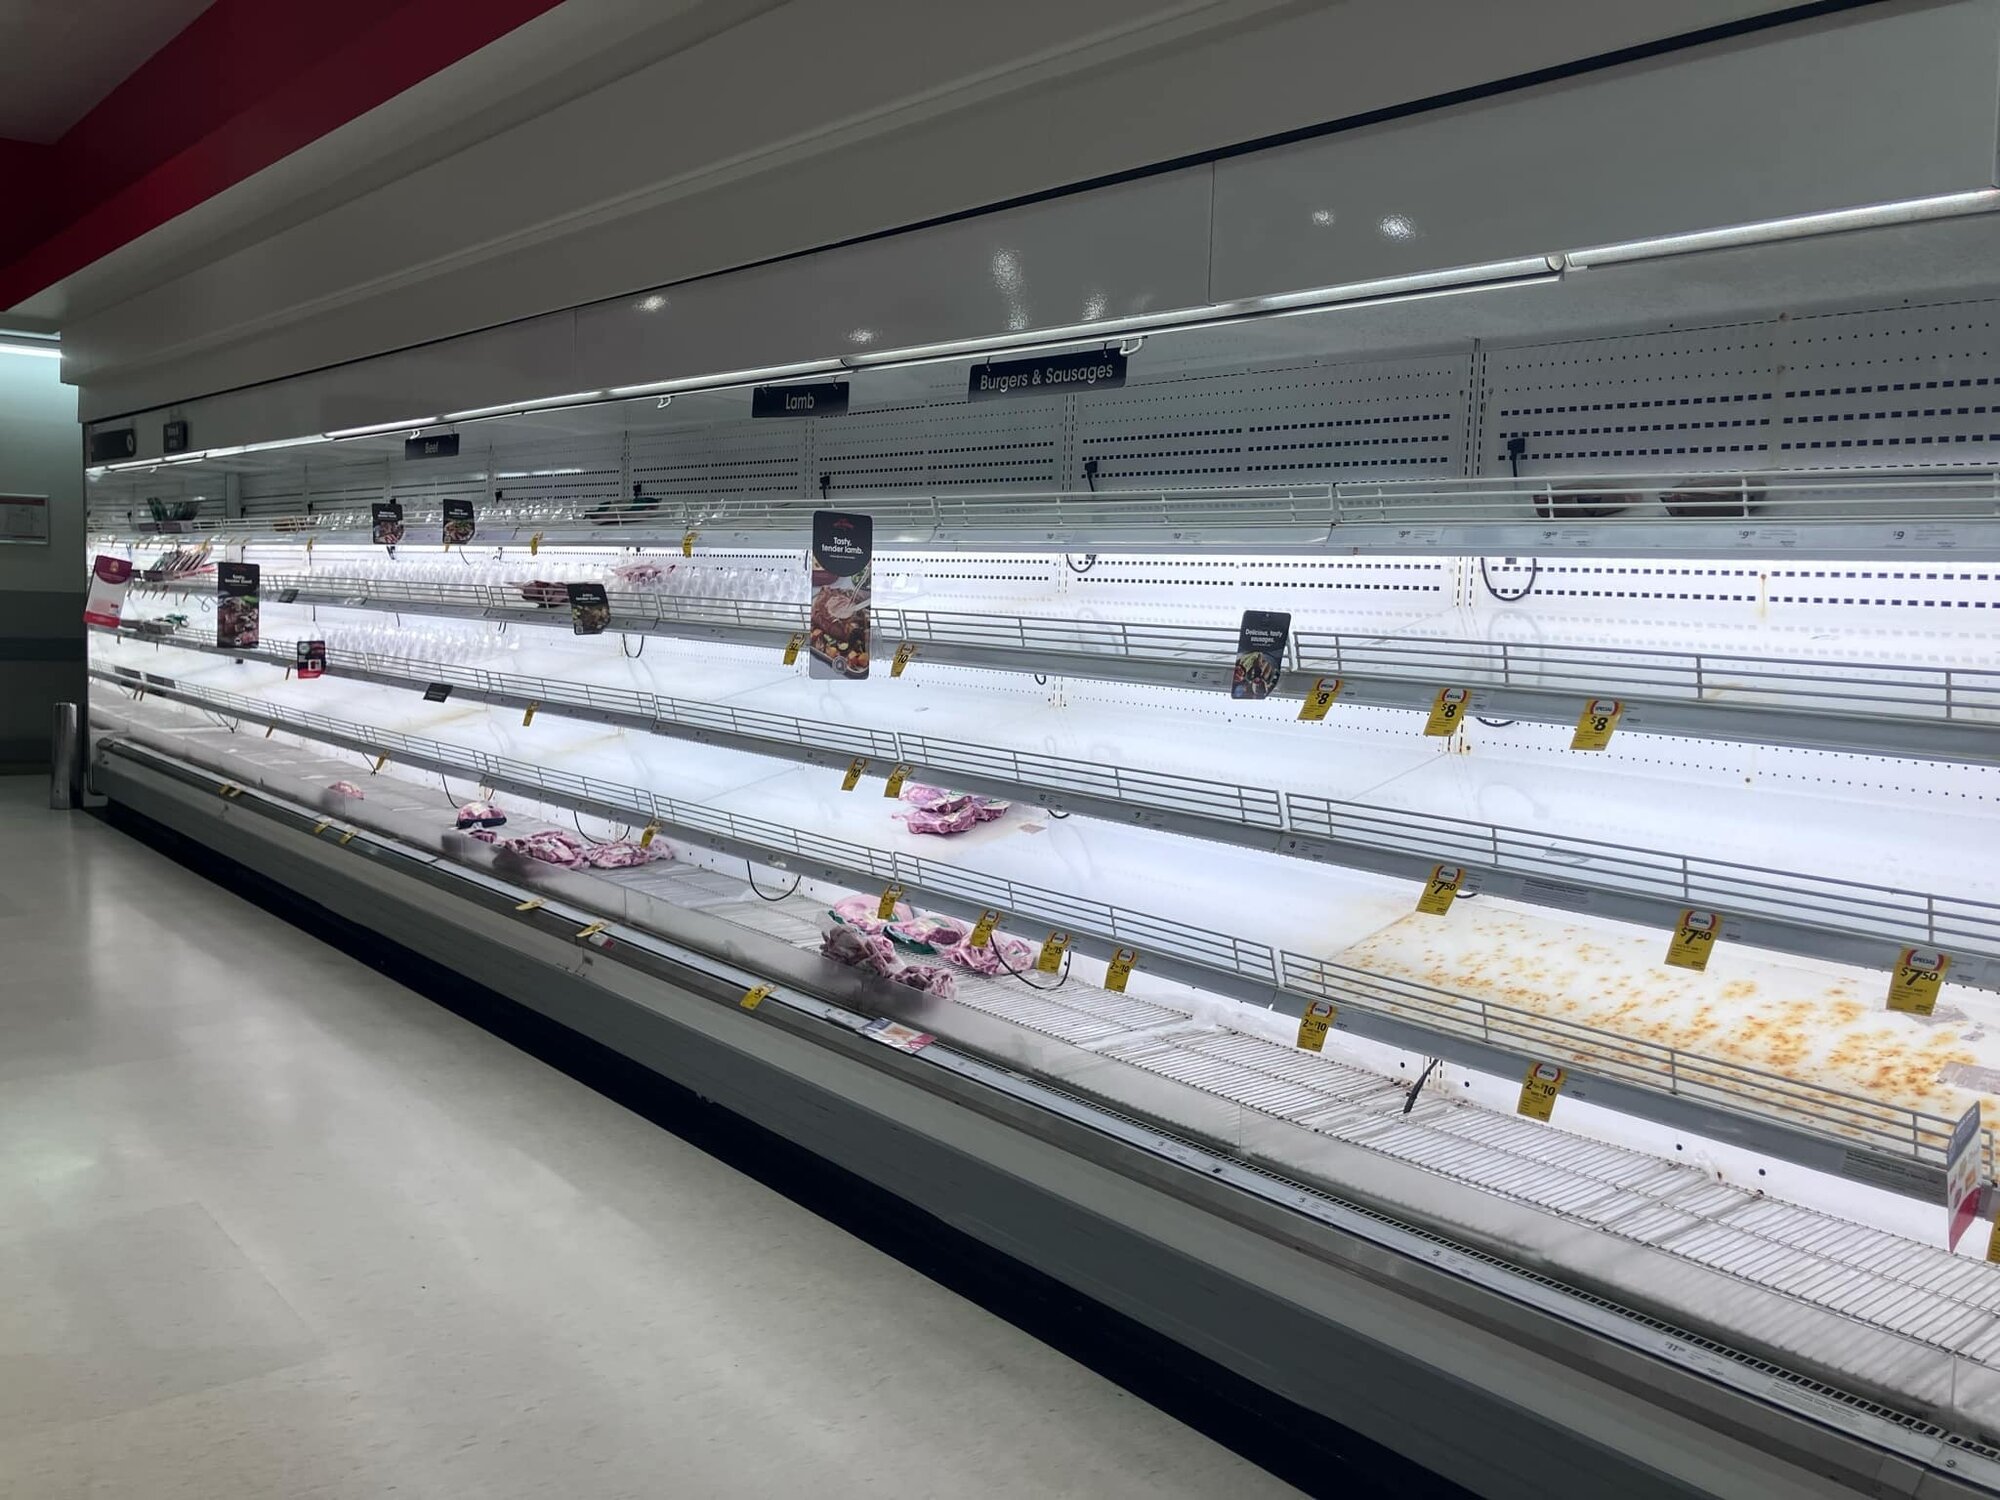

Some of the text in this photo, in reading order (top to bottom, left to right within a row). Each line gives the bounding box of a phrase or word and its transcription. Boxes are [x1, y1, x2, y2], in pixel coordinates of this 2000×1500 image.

[980, 363, 1113, 393] Burgers & Sausages
[785, 392, 815, 410] Lamb
[821, 543, 843, 553] tender
[1315, 691, 1330, 705] $8
[1441, 702, 1457, 718] $8
[1589, 716, 1608, 731] $8
[1690, 916, 1709, 925] SPECIAL
[1912, 956, 1936, 965] SPECIAL
[1303, 1019, 1309, 1028] 2
[1526, 1080, 1533, 1090] 2
